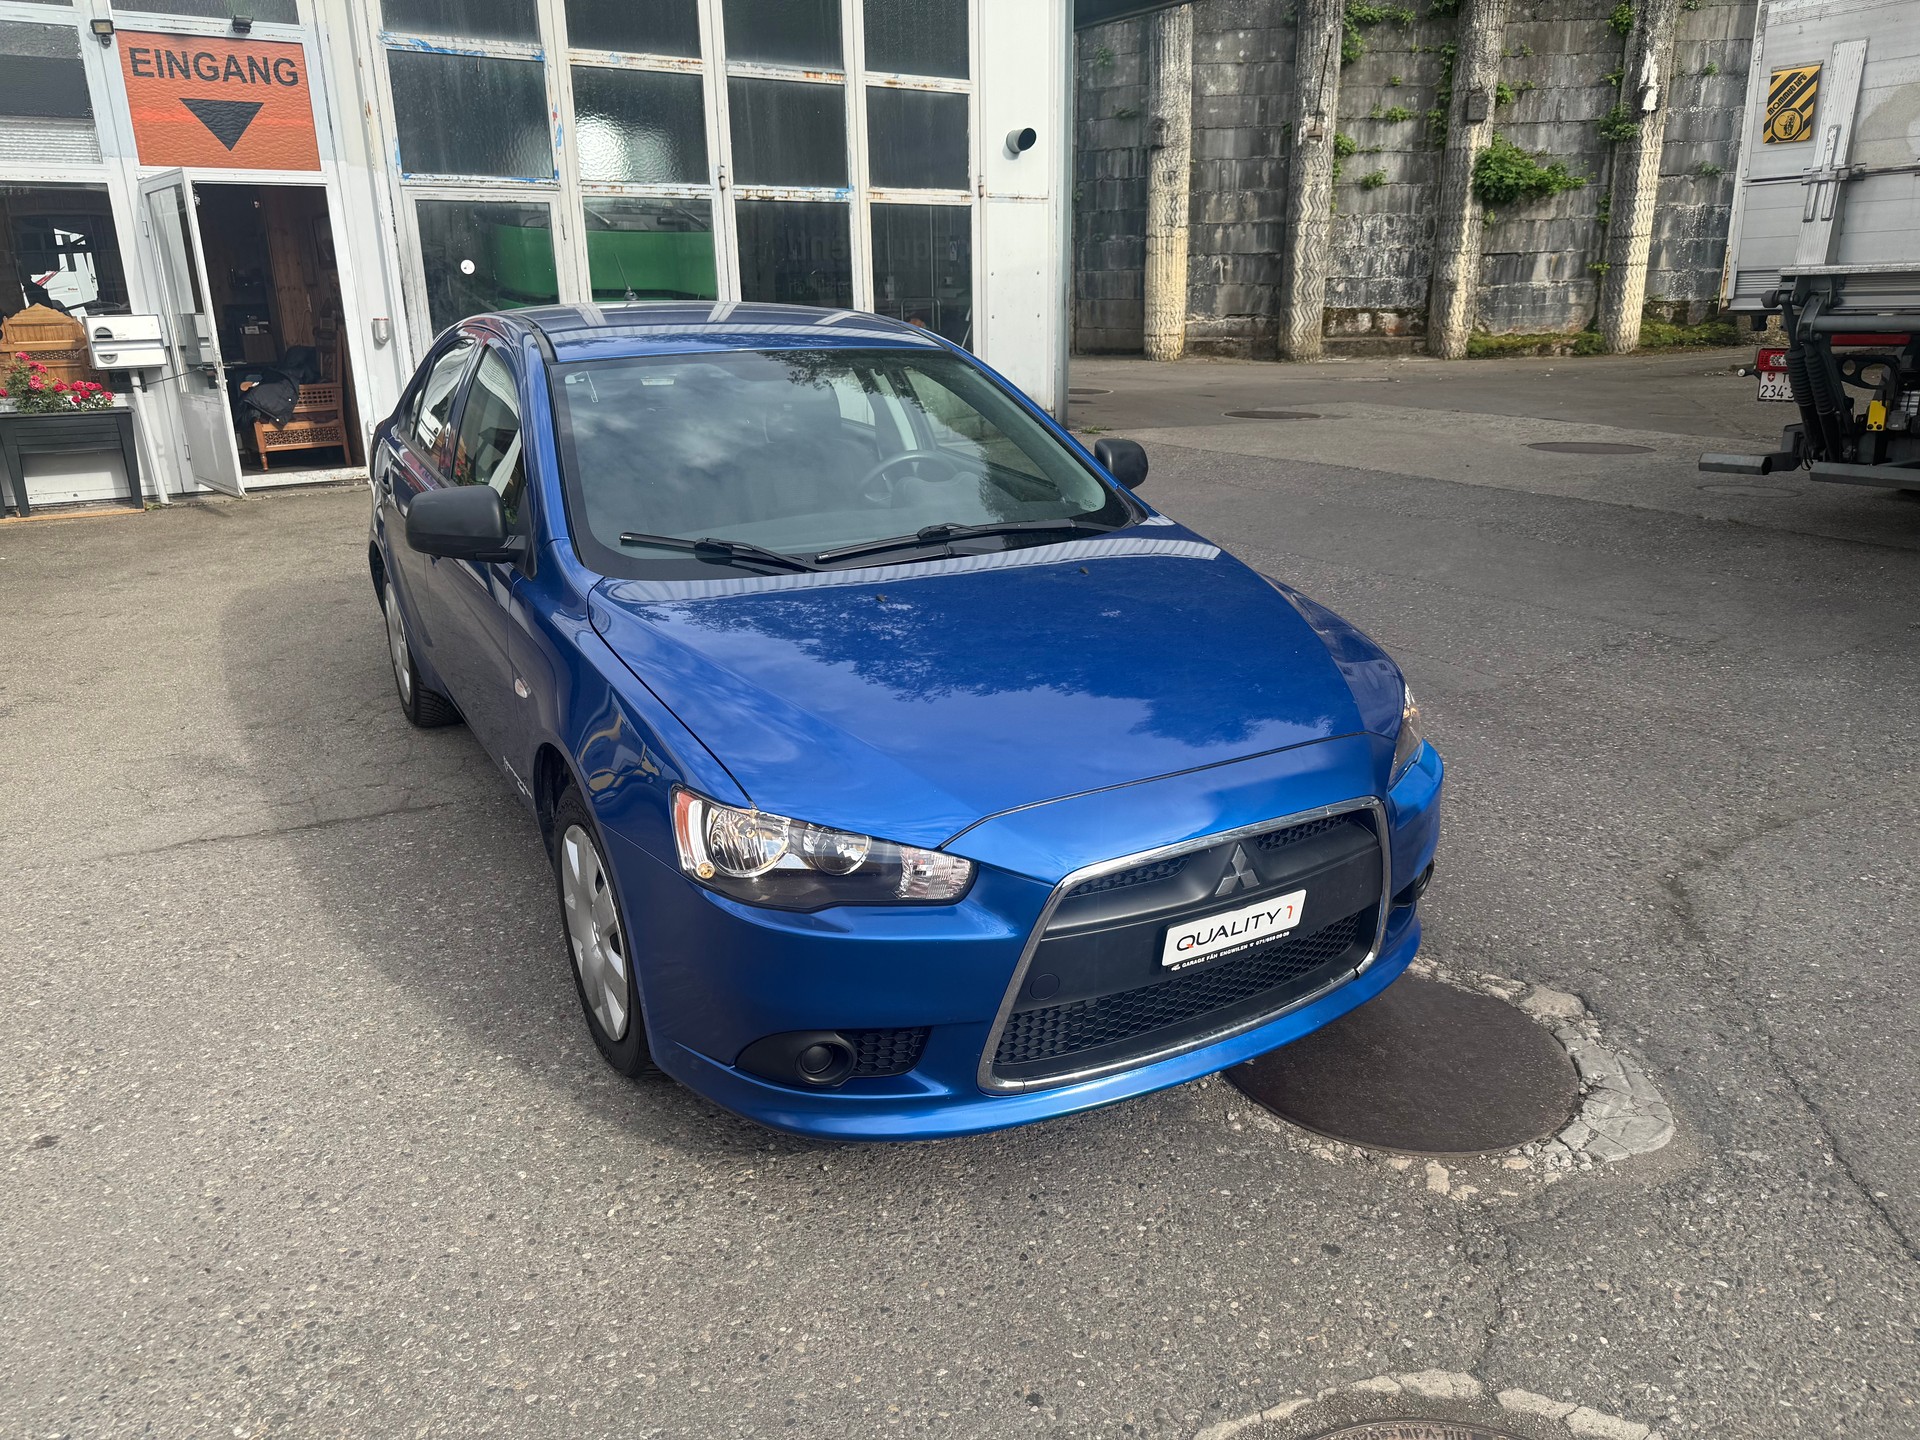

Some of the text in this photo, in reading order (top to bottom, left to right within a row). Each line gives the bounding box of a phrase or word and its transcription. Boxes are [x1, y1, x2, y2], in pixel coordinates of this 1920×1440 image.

[128, 47, 299, 87] EINGANG
[1176, 907, 1282, 952] QUALITY
[1181, 957, 1206, 968] GARAGE
